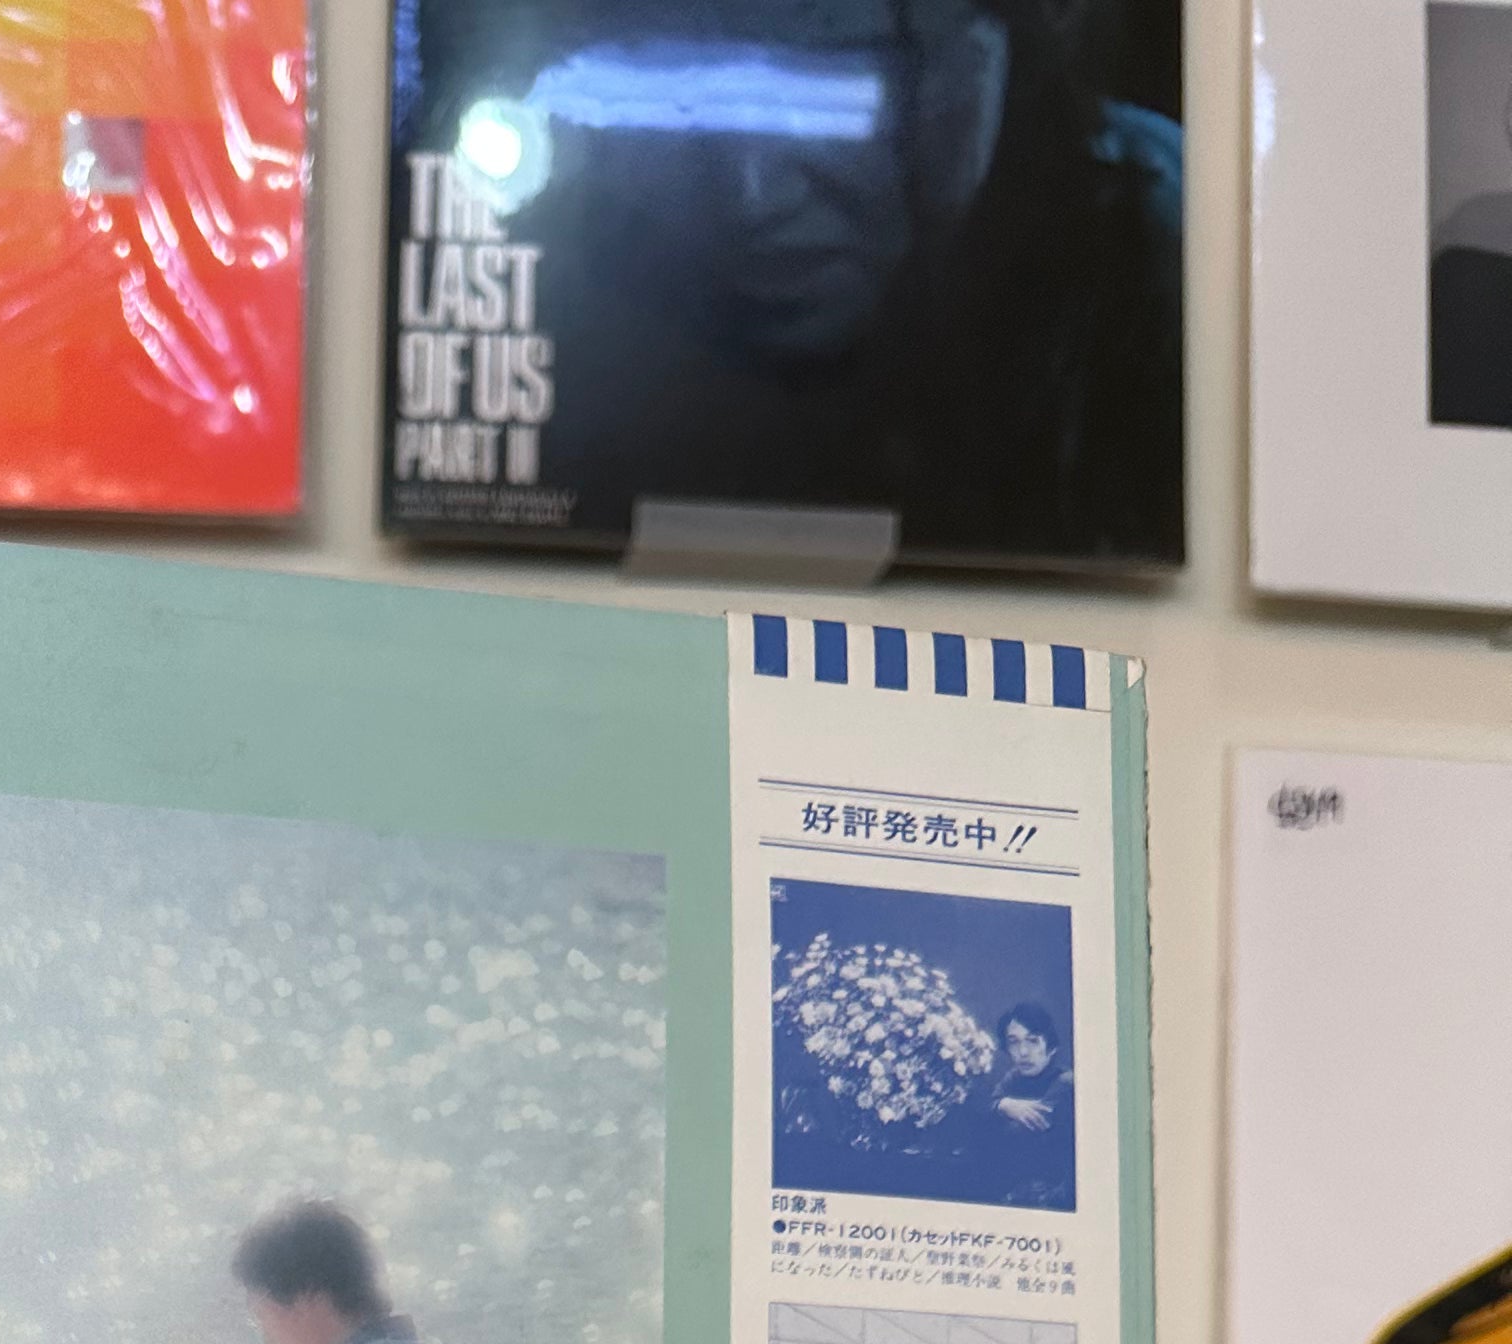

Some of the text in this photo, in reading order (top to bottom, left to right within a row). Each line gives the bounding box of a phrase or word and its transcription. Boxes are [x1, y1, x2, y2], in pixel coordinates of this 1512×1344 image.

[398, 241, 544, 330] LAST
[398, 332, 555, 424] OF US
[394, 421, 502, 484] PART
[801, 801, 1038, 854] 好評発売中!!
[772, 1194, 826, 1214] 印象派
